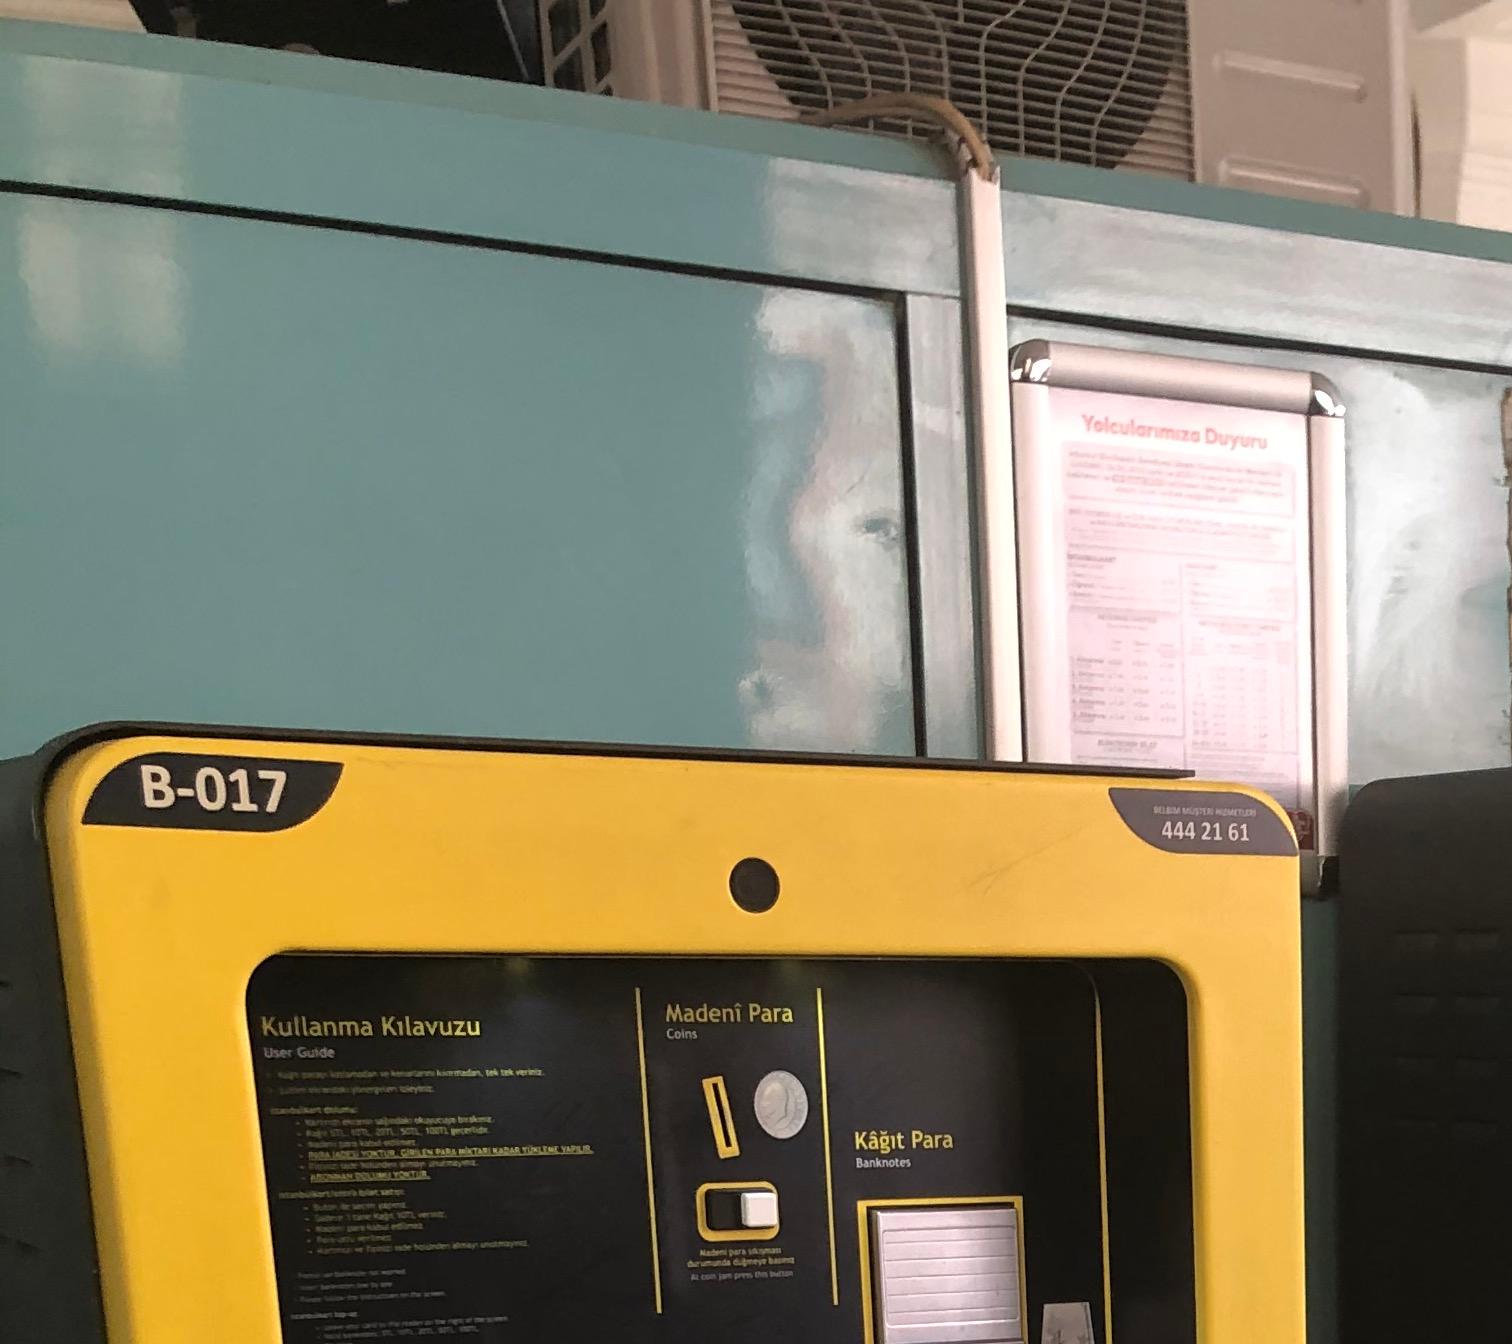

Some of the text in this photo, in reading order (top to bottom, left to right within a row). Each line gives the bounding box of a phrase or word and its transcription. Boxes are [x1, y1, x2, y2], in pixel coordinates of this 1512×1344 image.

[1206, 427, 1268, 451] Duyuru
[140, 764, 287, 813] B-017
[1161, 821, 1250, 842] 444 21 61
[666, 1003, 794, 1023] Madenî Para
[262, 1014, 481, 1038] Kullanma Kılavuzu
[666, 1028, 698, 1040] Coins
[263, 1046, 336, 1059] User Guide
[854, 1130, 954, 1154] Kâğıt Para
[856, 1157, 912, 1169] Banknotes
